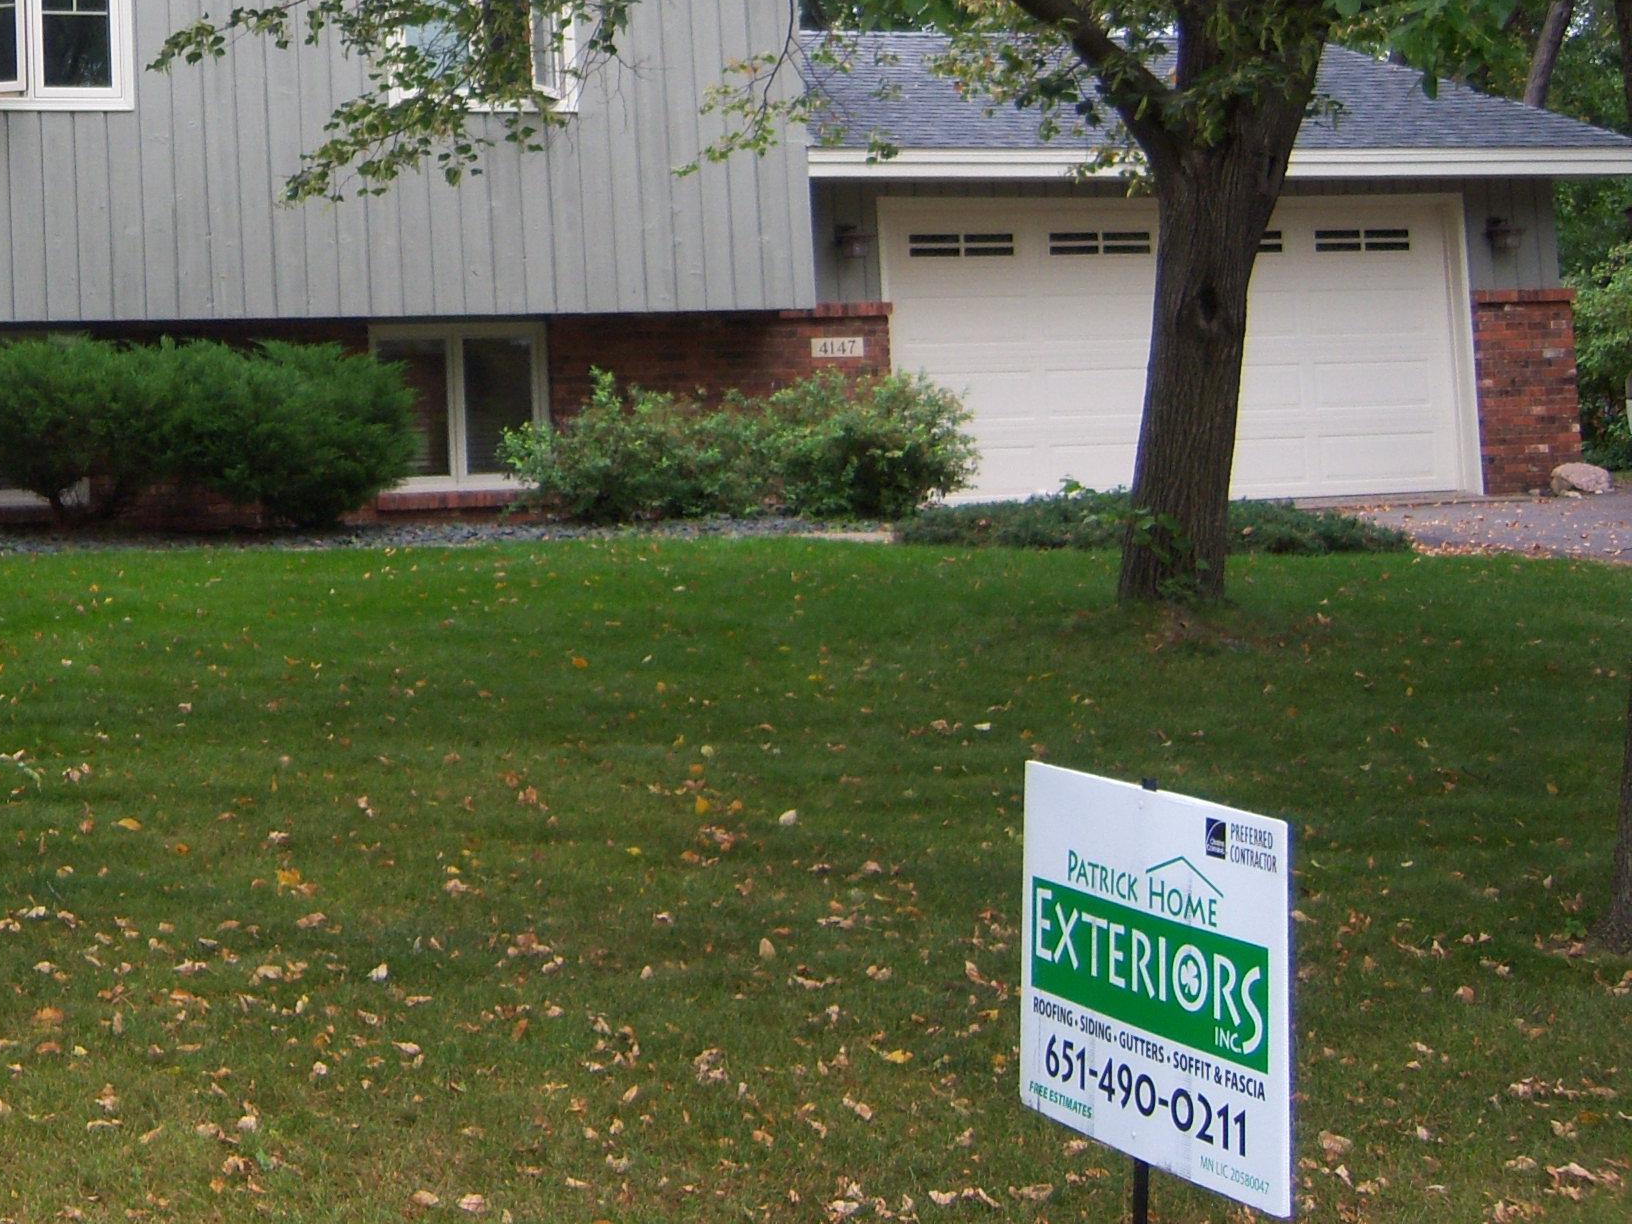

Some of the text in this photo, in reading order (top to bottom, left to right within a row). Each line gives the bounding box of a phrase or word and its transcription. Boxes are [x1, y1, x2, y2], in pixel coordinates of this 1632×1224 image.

[818, 340, 856, 355] 4147
[1230, 823, 1274, 850] PREFERRED
[1230, 844, 1277, 873] CONTRACTOR
[1068, 849, 1217, 927] PATRICK HOME
[1035, 887, 1264, 1055] EXTERIORS
[1033, 996, 1266, 1102] ROOFING SIDING GUTTERS SOFFIT & FASCIA
[1029, 1080, 1093, 1118] FREE ESTIMATES
[1045, 1033, 1246, 1158] 651-490-0211
[1200, 1155, 1214, 1172] MN
